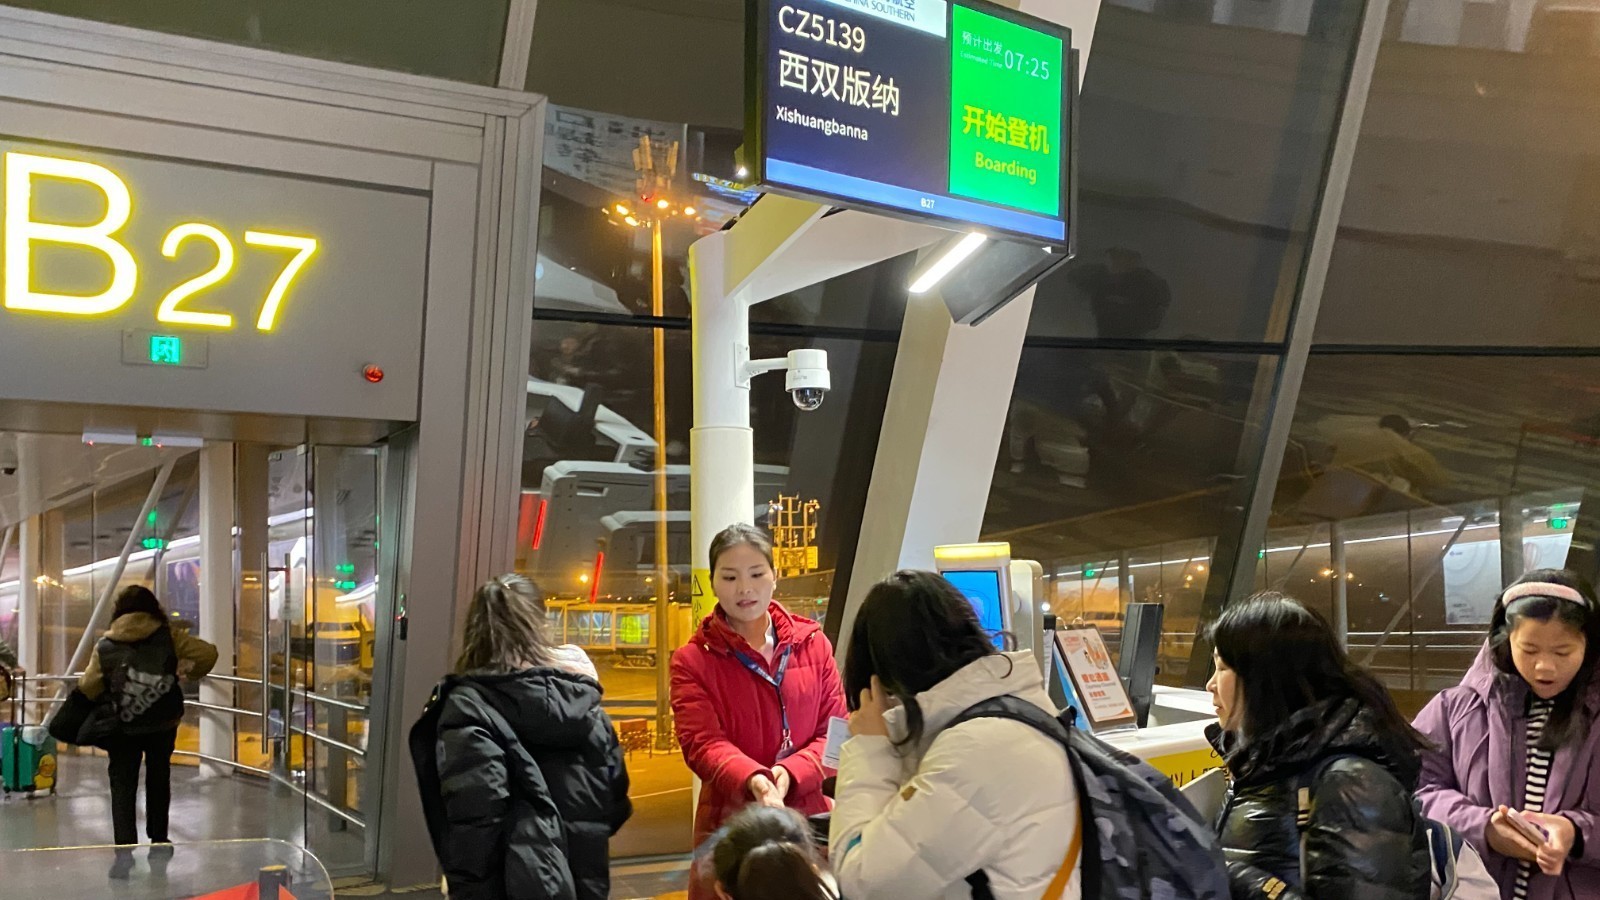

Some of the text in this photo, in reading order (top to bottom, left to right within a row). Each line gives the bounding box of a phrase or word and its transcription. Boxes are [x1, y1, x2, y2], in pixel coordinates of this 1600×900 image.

[871, 1, 915, 21] SOUTHERN
[778, 5, 865, 53] CZ5139
[962, 31, 1003, 55] 预计出发
[1004, 49, 1050, 80] 07:25
[778, 49, 900, 116] 西双版纳
[776, 105, 868, 140] Xishuangbanna
[962, 104, 1050, 154] 开始登机
[975, 151, 1037, 185] Boarding
[920, 198, 935, 209] B27
